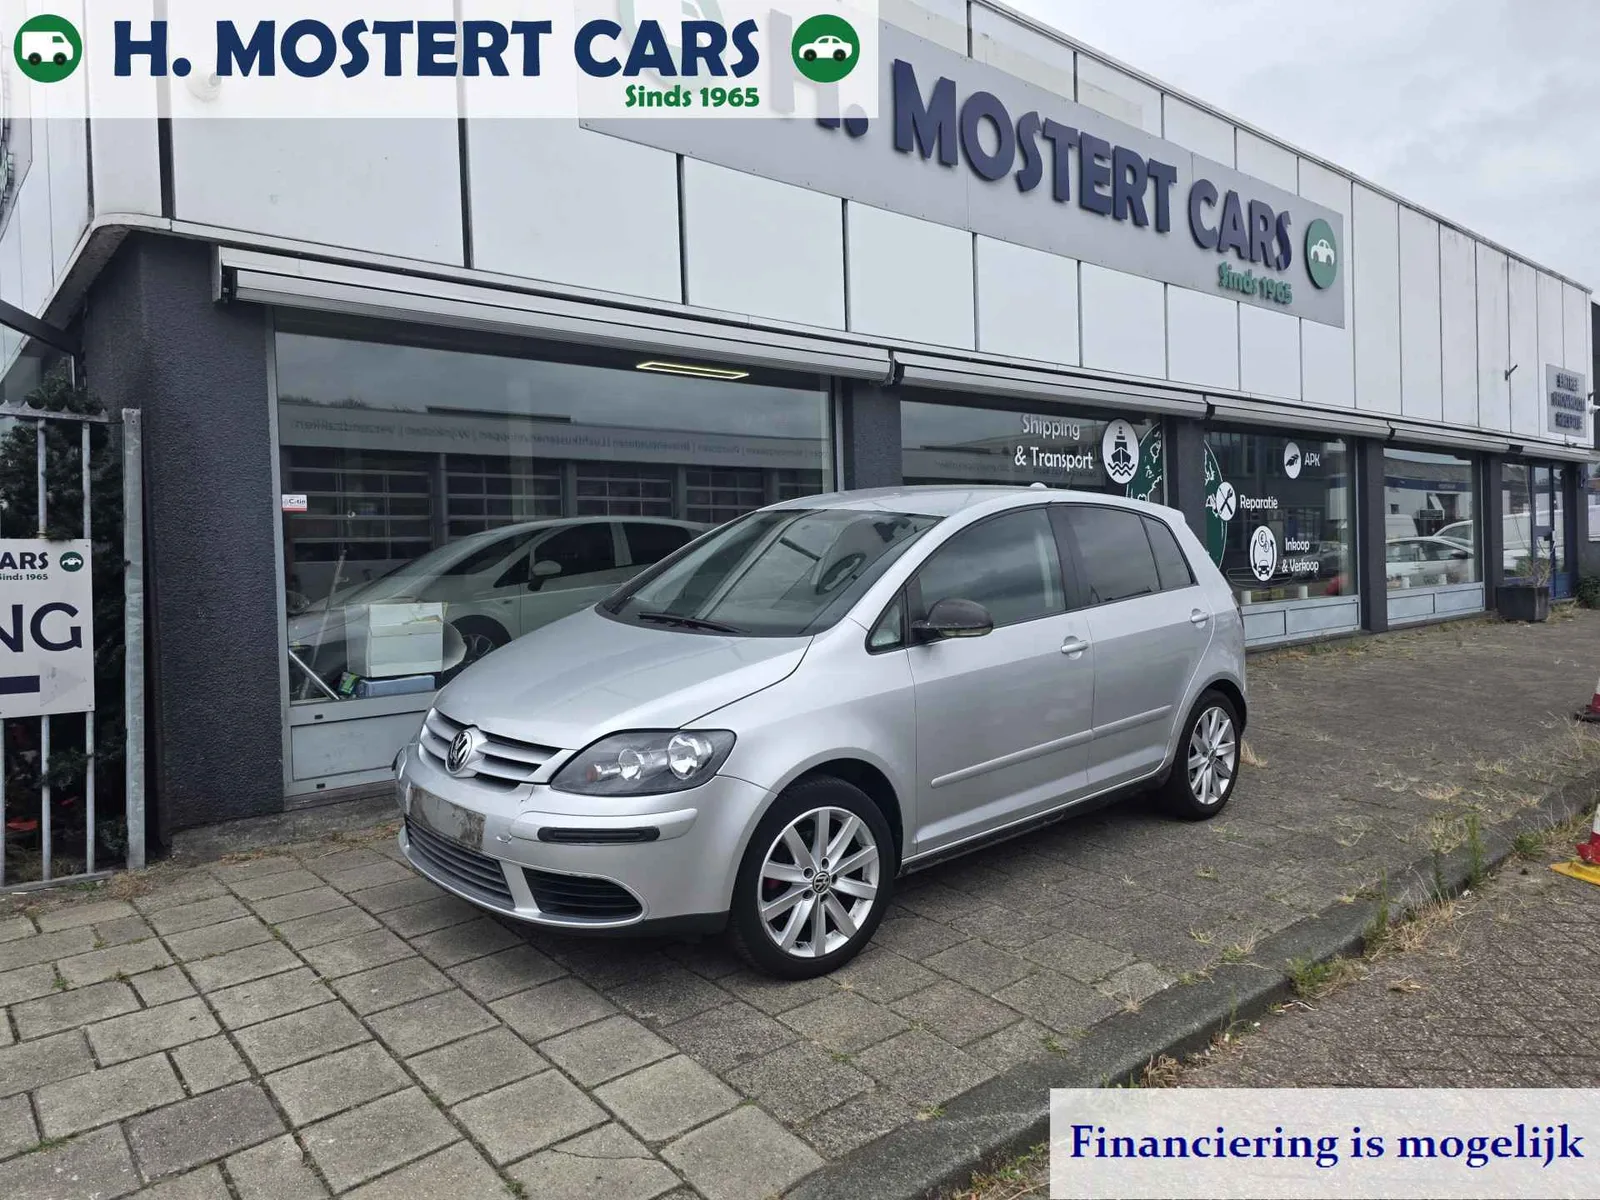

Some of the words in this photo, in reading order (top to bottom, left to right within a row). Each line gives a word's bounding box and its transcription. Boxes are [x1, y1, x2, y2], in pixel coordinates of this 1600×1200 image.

[891, 58, 1177, 233] MOSTERT
[1188, 178, 1293, 272] CARS
[1218, 261, 1258, 295] Sinds
[1258, 276, 1293, 305] 1965
[1022, 413, 1081, 441] Shipping
[1014, 445, 1027, 466] &
[1030, 446, 1094, 473] Transport
[1304, 452, 1321, 467] APK
[1240, 494, 1279, 511] Reparatie
[1285, 537, 1310, 553] Inkoop
[1281, 559, 1288, 573] &
[1289, 559, 1320, 574] Verkoop
[26, 573, 49, 581] 1965
